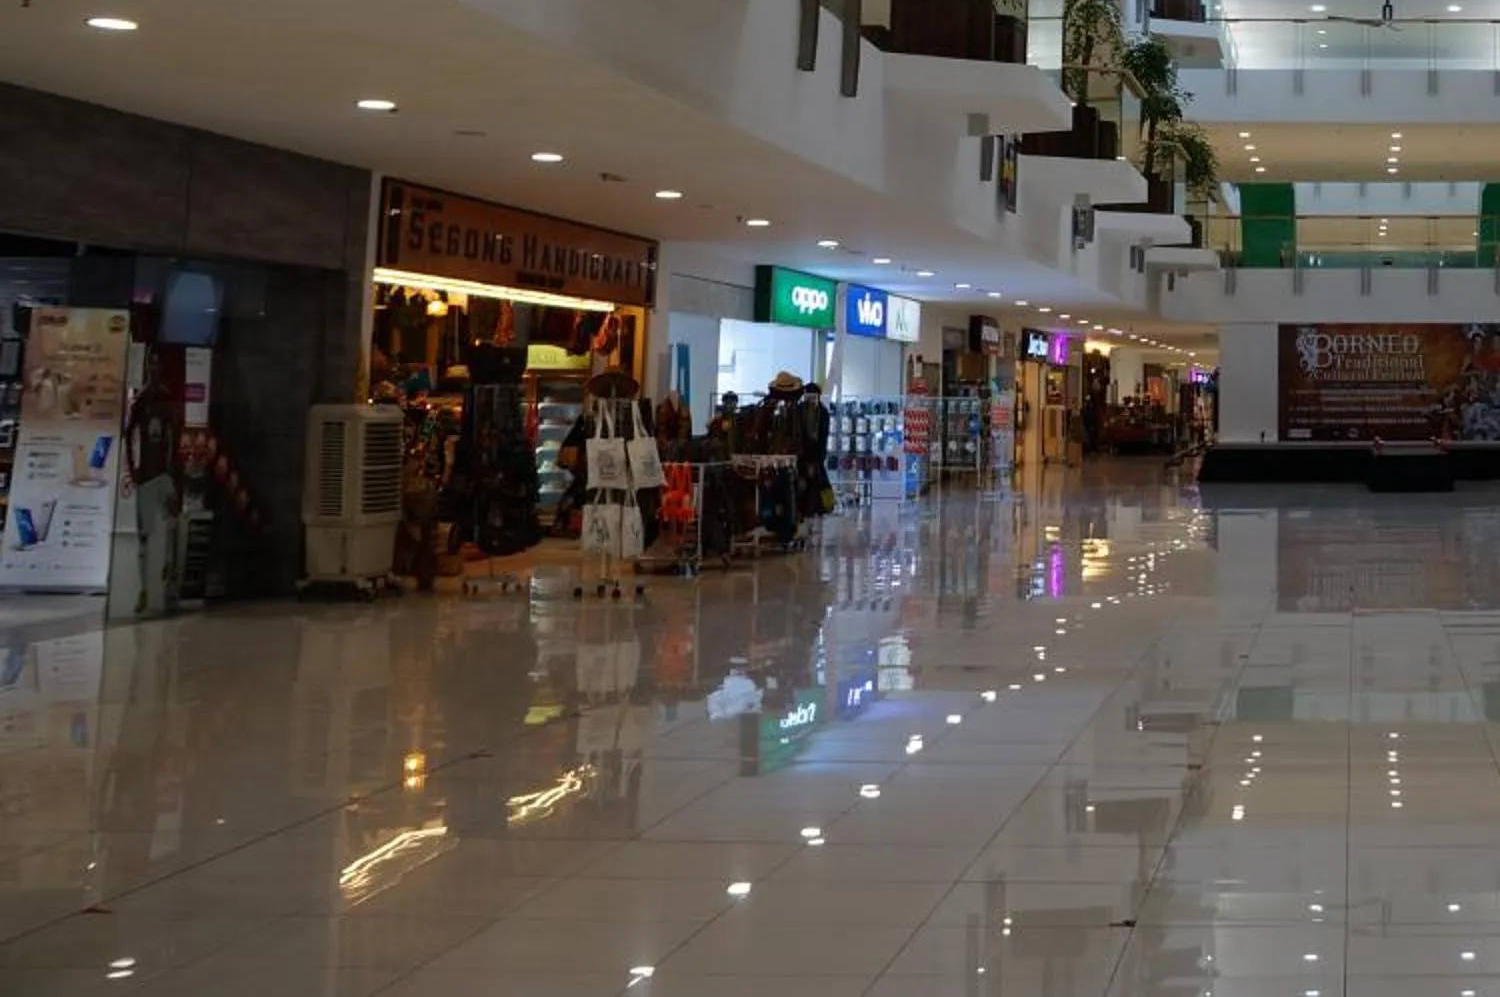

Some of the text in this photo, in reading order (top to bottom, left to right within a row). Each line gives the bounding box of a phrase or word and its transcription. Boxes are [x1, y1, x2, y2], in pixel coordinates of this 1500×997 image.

[523, 234, 647, 288] HANDICRAFT
[791, 286, 829, 315] oppo
[857, 291, 884, 327] vivo
